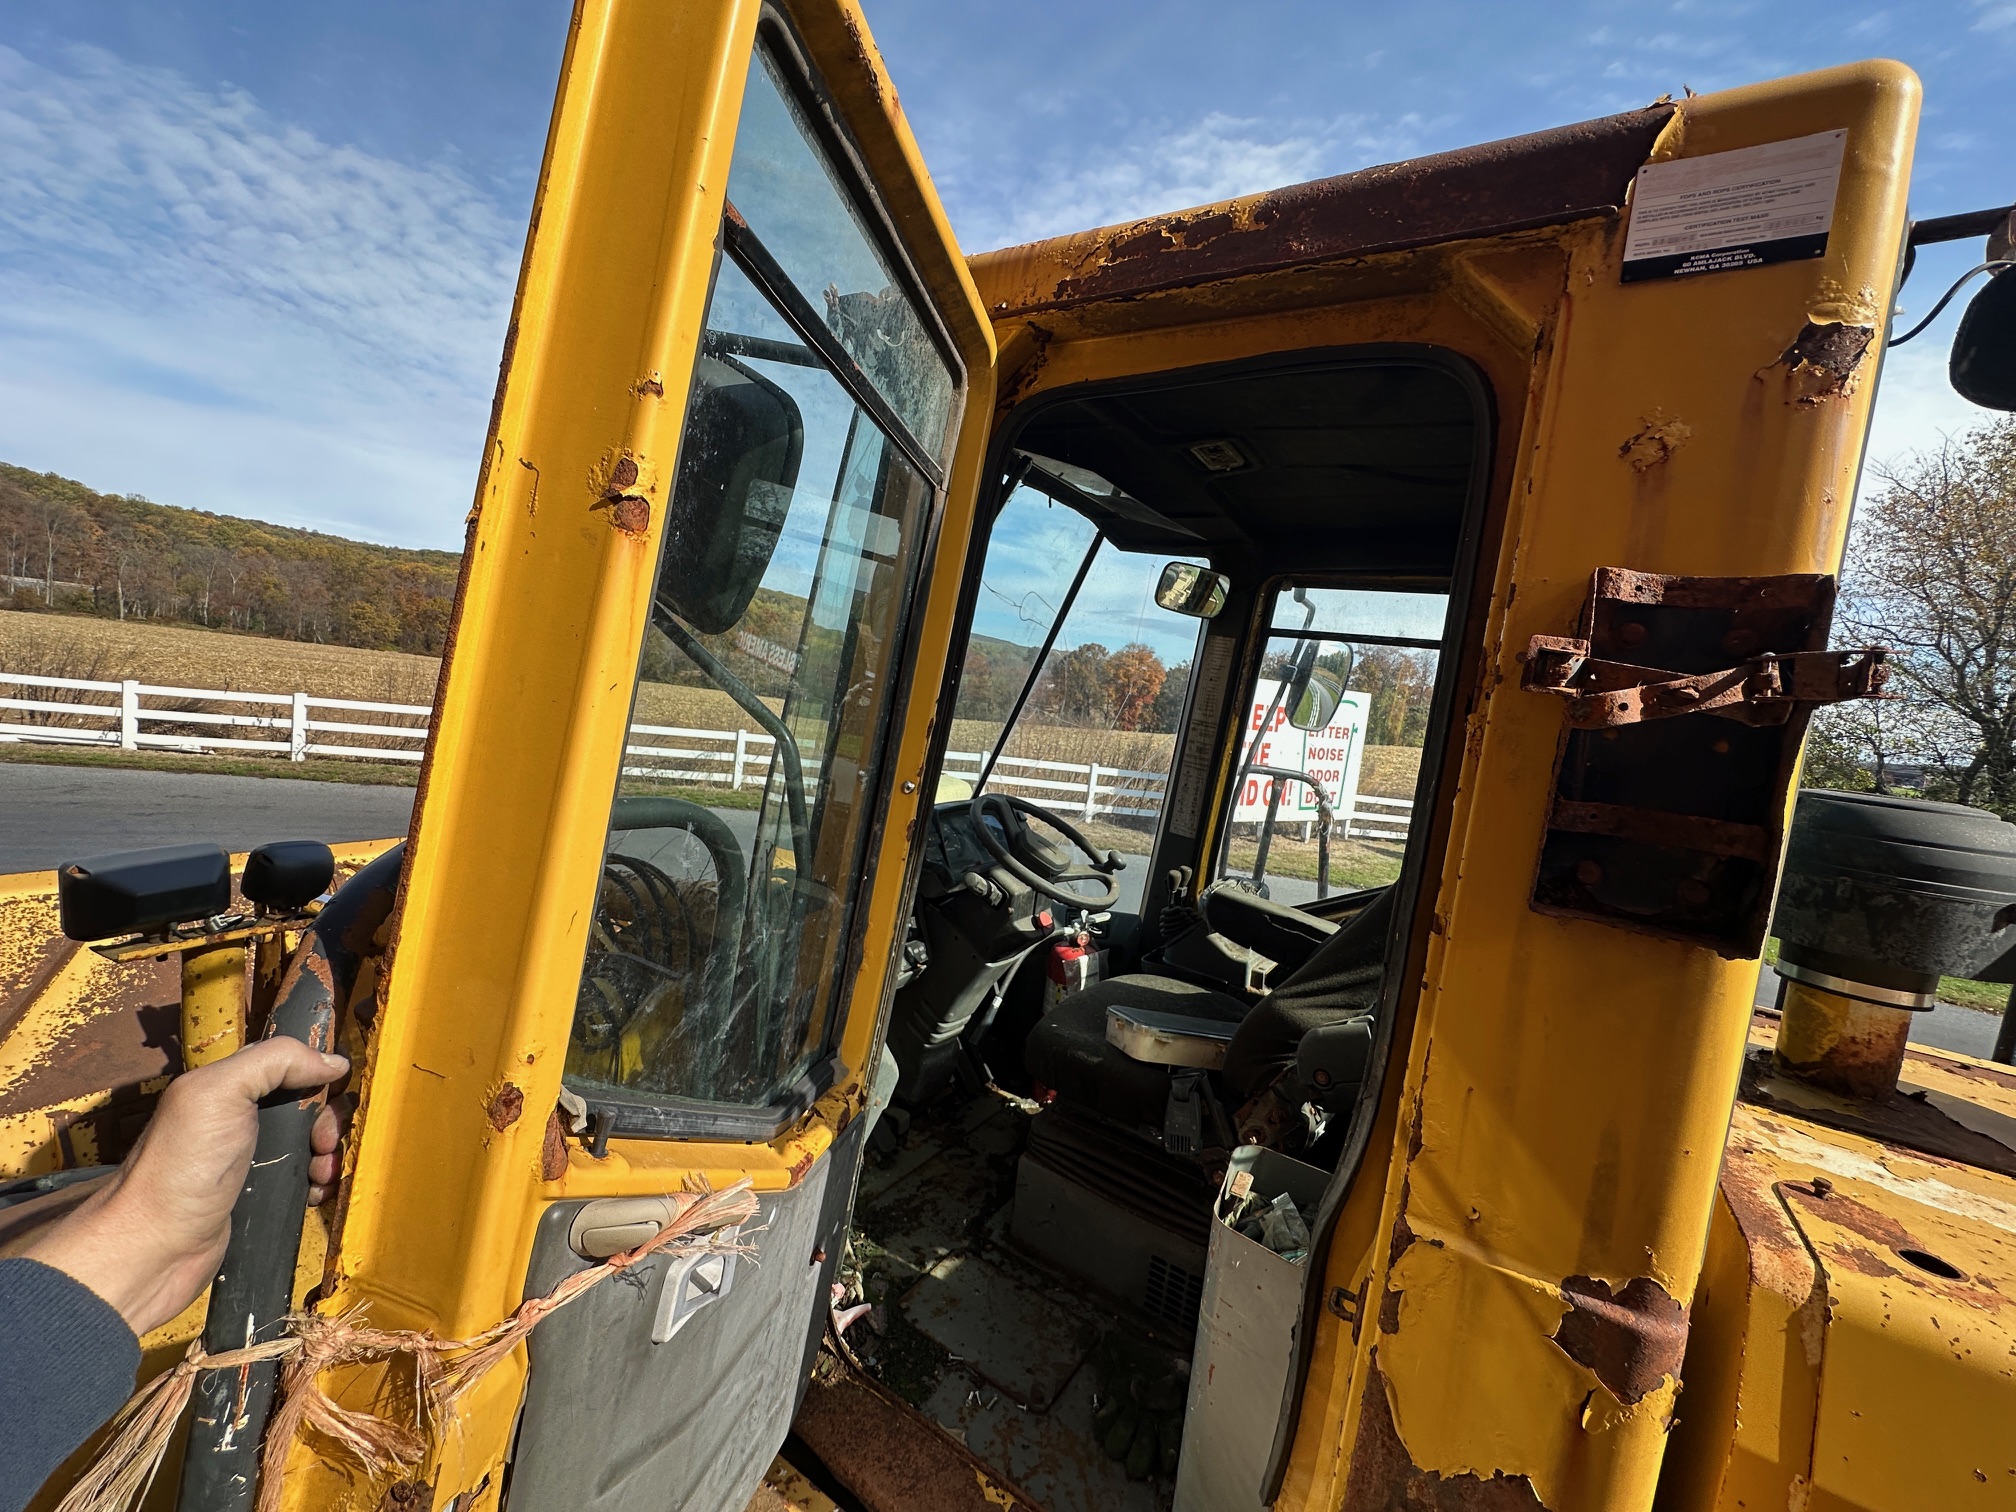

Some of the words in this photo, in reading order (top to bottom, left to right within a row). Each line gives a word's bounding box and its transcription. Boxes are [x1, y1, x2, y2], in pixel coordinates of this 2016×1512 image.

[1731, 178, 1781, 190] CERTIFICATION
[1684, 218, 1731, 230] CERTIFICATION
[1710, 247, 1749, 258] Corporation
[1692, 256, 1732, 266] AMLAJACK
[1308, 747, 1344, 761] NOISE
[1308, 769, 1340, 782] ODOR
[1305, 791, 1336, 804] DT
